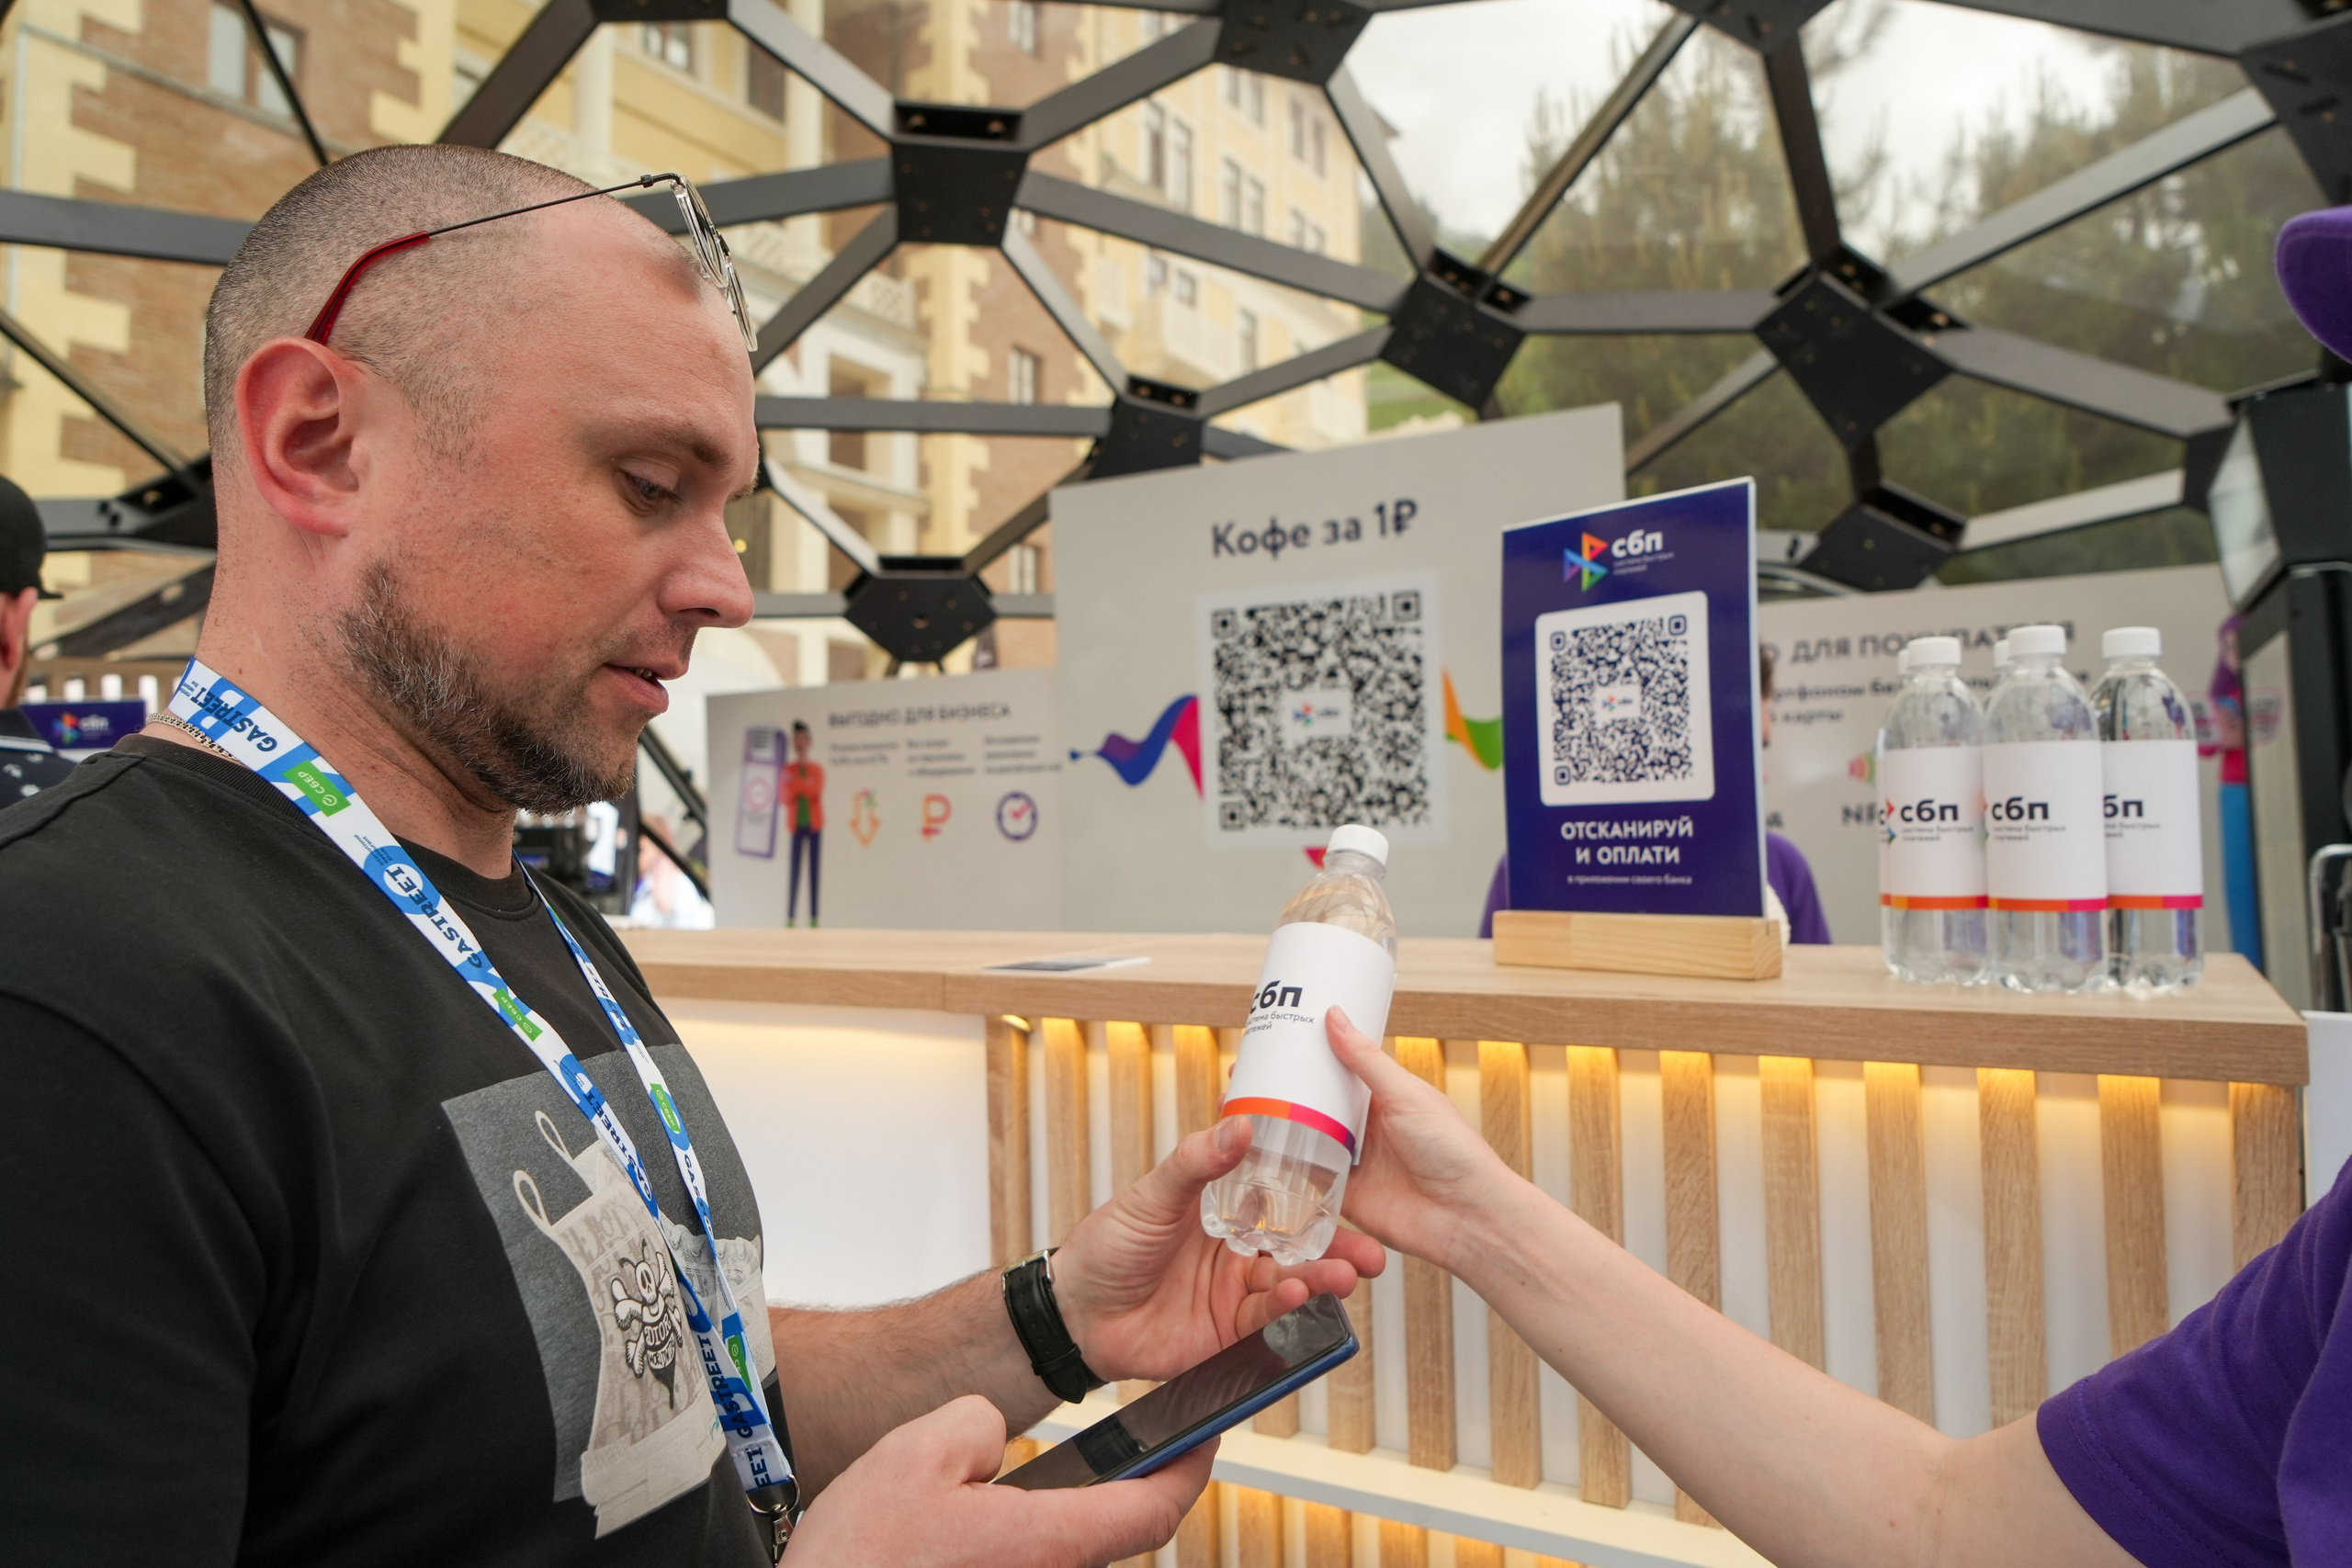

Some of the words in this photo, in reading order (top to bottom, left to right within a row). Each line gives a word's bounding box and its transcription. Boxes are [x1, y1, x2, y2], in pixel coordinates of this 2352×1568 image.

[1212, 515, 1311, 559] Кофе
[1323, 516, 1362, 546] за
[1611, 529, 1663, 558] сбп
[1792, 638, 1850, 663] ДЛЯ
[190, 686, 278, 752] GASTREET
[297, 771, 325, 795] СБЕР
[1900, 799, 1959, 822] сбп
[1992, 796, 2049, 821] сбп
[2104, 795, 2143, 818] бп
[1561, 816, 1693, 840] ОТСКАНИРУЙ
[1576, 847, 1590, 864] И
[1597, 846, 1680, 865] ОПЛАТИ
[384, 865, 482, 968] GASTREET
[501, 996, 522, 1021] СБЕР
[1250, 980, 1303, 1014] сбп
[1271, 1011, 1315, 1024] быстрых
[583, 1093, 651, 1201] GASTREET
[697, 1335, 753, 1438] GASTREET
